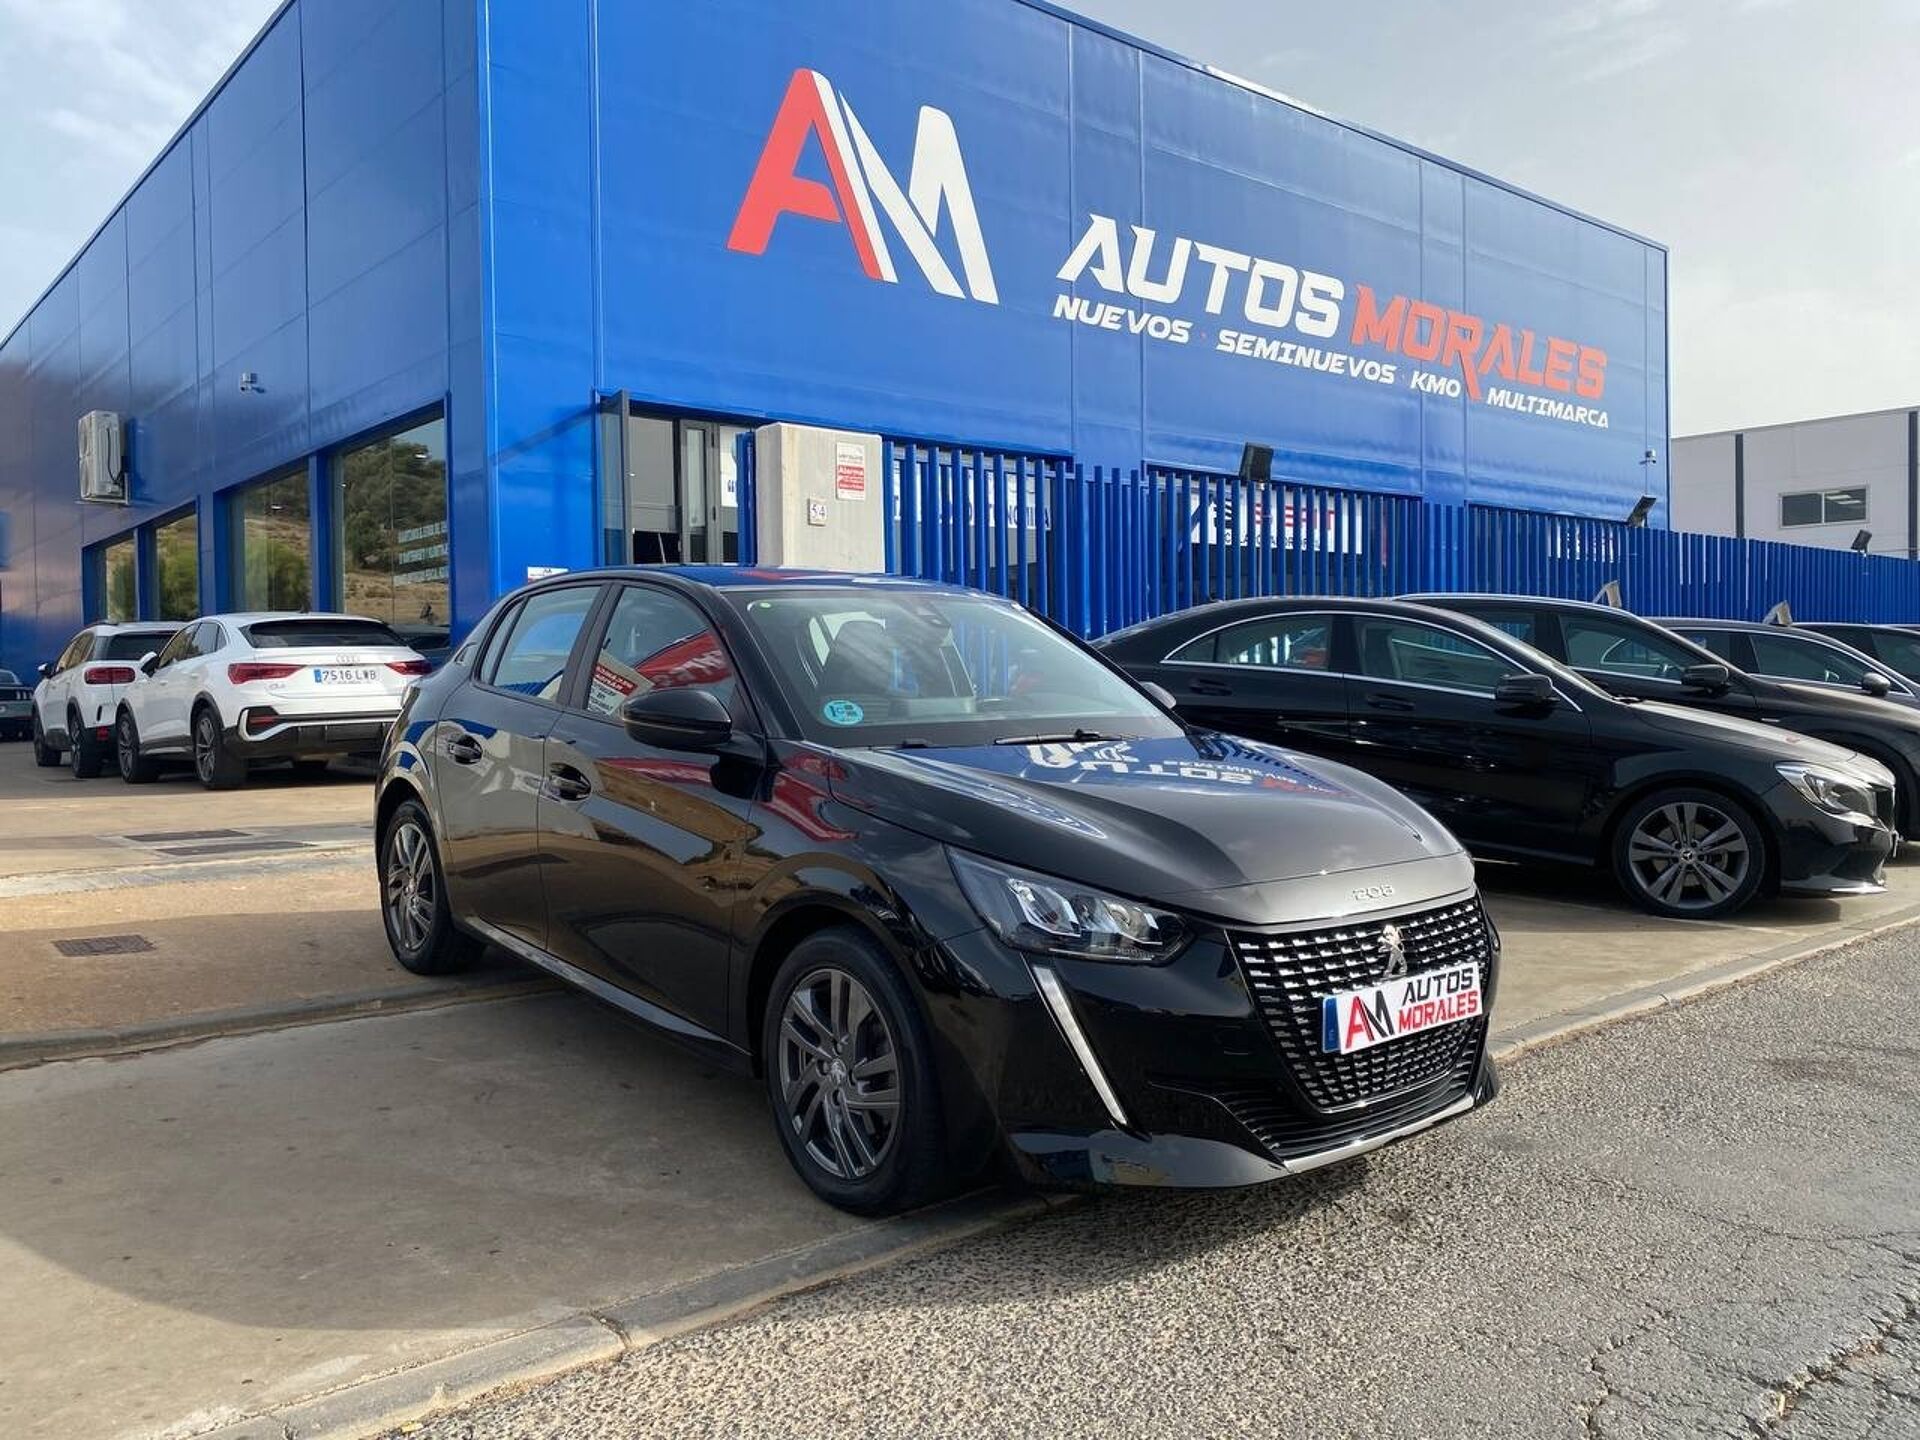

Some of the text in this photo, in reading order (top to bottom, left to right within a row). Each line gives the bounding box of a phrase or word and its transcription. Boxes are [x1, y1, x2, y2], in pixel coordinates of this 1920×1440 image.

[727, 67, 1000, 305] AM
[1056, 213, 1608, 400] AUTOS MORALES
[1053, 294, 1194, 344] NUEVOS
[1216, 329, 1397, 385] SEMINUEVOS
[1487, 387, 1609, 428] MULTIMARCA
[322, 670, 352, 682] 7516
[1352, 884, 1395, 900] 208
[1399, 990, 1479, 1033] MORALES
[1402, 967, 1474, 1007] AUTOS
[1345, 990, 1396, 1049] AM
